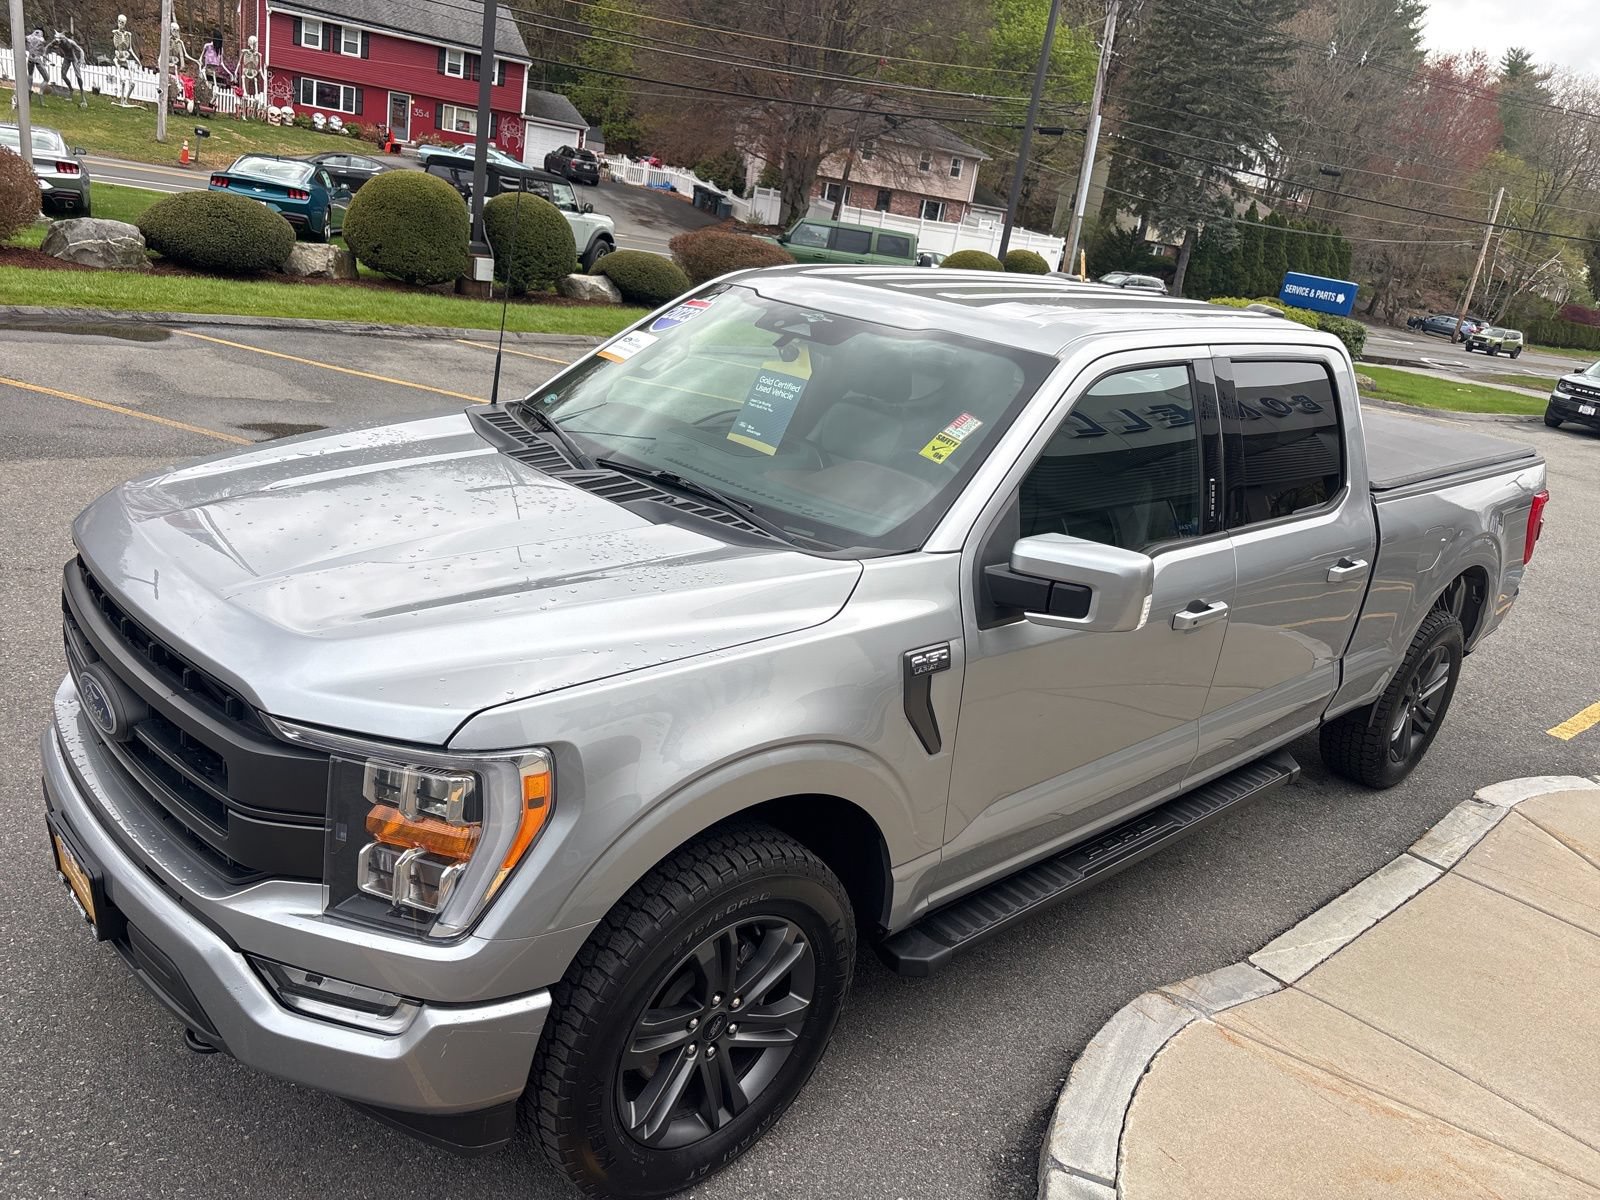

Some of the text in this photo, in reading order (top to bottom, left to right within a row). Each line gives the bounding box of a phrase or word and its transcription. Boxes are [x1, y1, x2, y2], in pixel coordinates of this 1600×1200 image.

[413, 108, 430, 119] 354
[1284, 284, 1337, 302] SERVICE & PARTS
[755, 383, 794, 401] Used Vehicle
[759, 375, 802, 393] Gold Certified
[936, 434, 958, 448] SAFETY
[933, 452, 944, 461] OK
